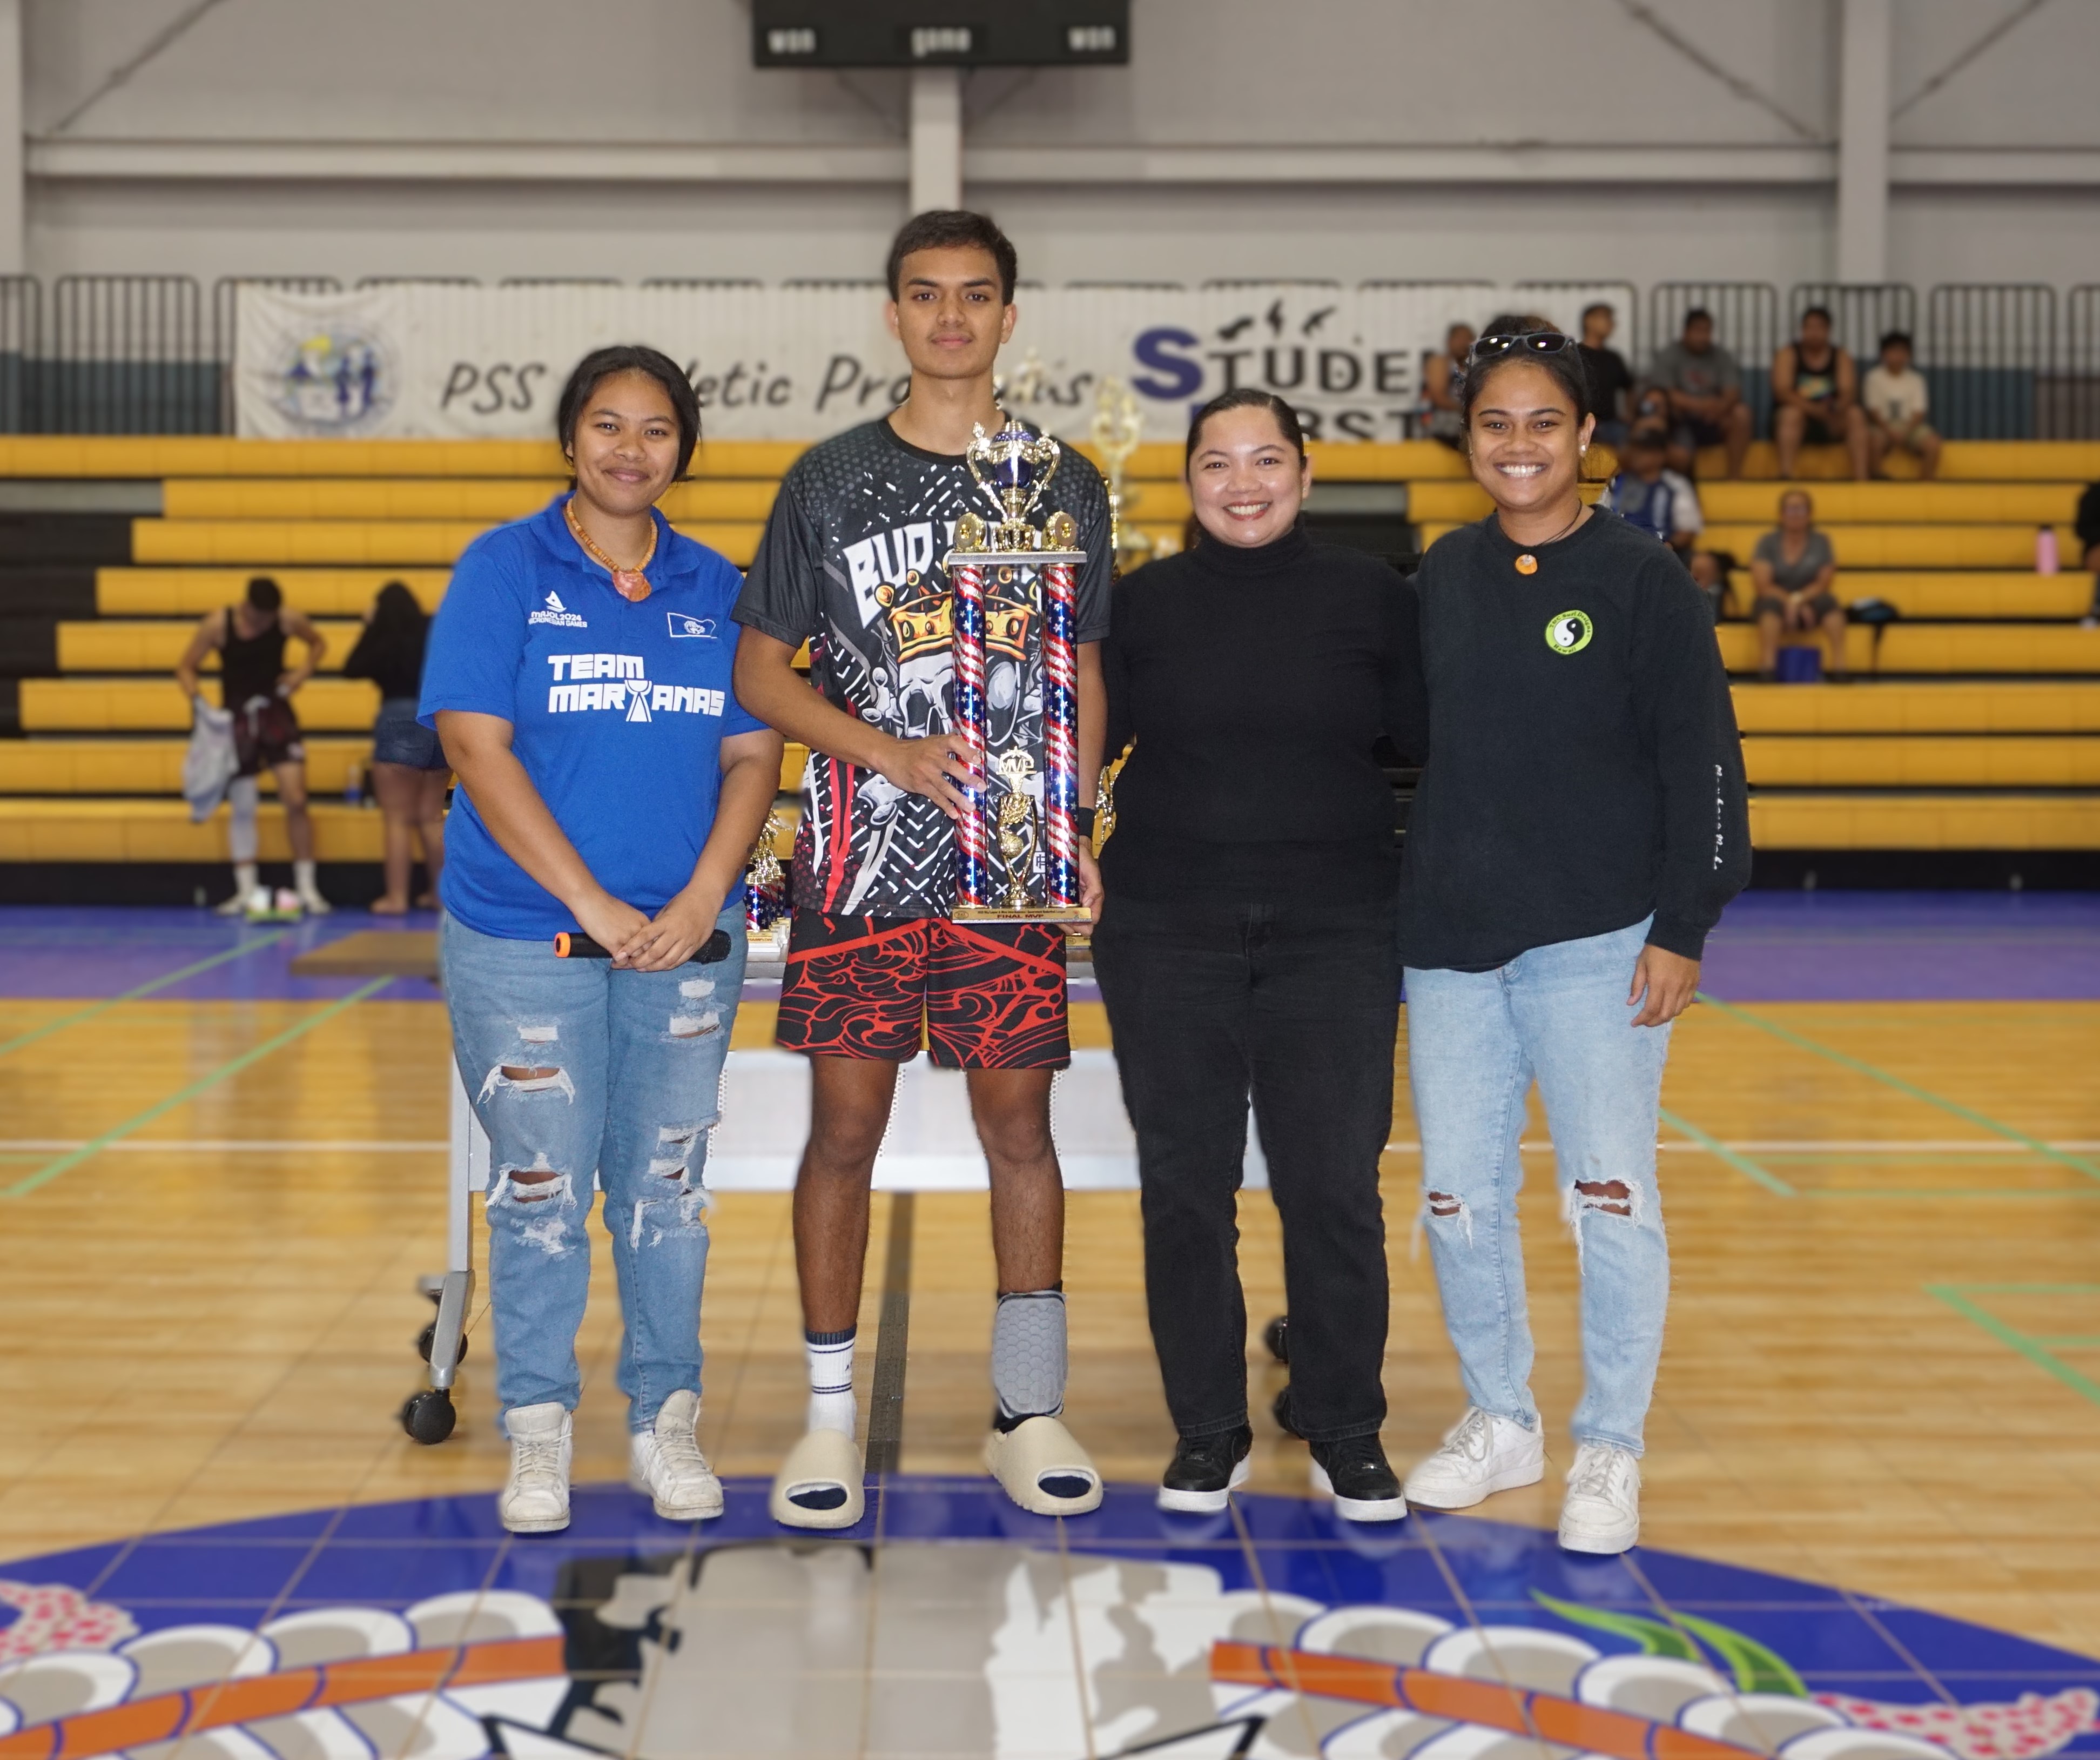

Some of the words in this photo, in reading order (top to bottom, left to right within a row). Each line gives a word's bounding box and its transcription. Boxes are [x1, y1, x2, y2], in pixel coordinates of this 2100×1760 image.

[1130, 326, 1435, 401] STUDE
[439, 361, 546, 415] PSS
[843, 521, 934, 629] BUD
[1577, 612, 1591, 633] Designs
[1553, 644, 1577, 653] Hawaii
[548, 654, 644, 681] TEAM
[999, 757, 1034, 774] MVP
